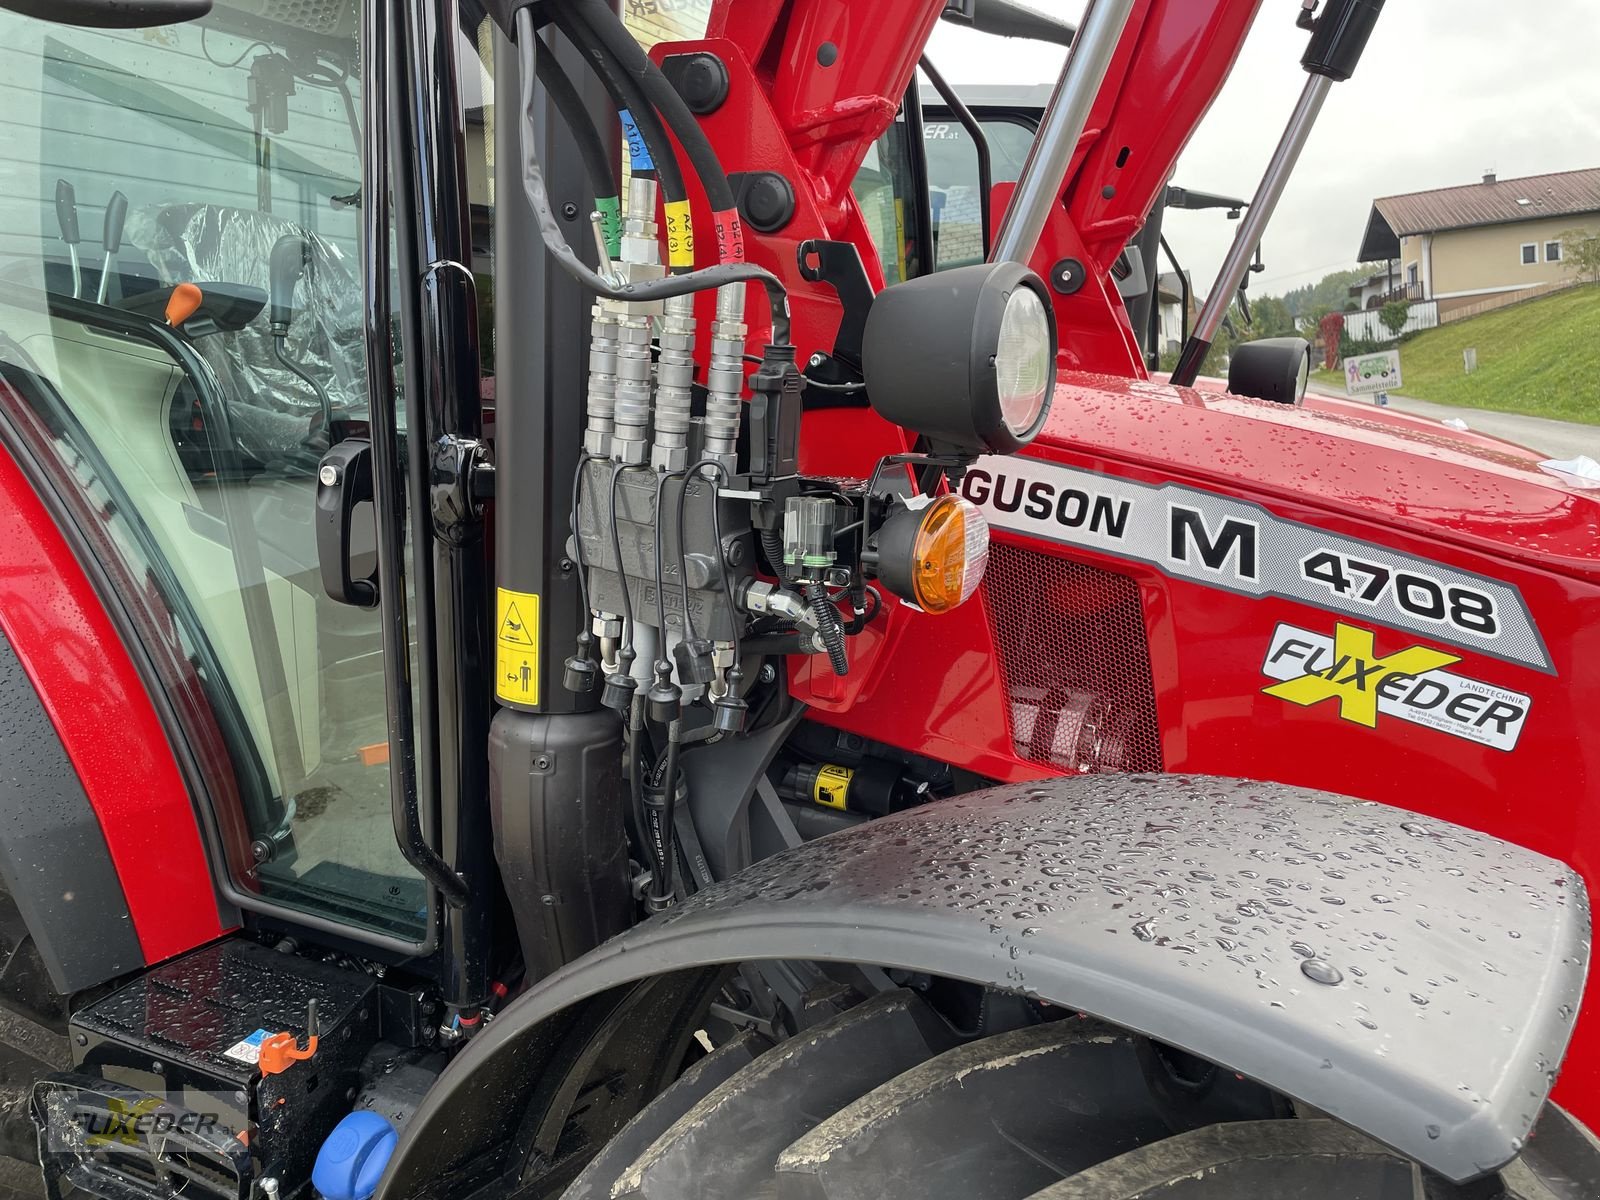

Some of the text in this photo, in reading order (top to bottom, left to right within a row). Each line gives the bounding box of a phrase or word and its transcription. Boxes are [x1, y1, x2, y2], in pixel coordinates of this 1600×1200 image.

[666, 215, 677, 233] A2
[950, 468, 1497, 635] GUSON M 4708
[1269, 638, 1525, 736] FLIXEDER
[1459, 681, 1526, 706] LANDTECHNIK
